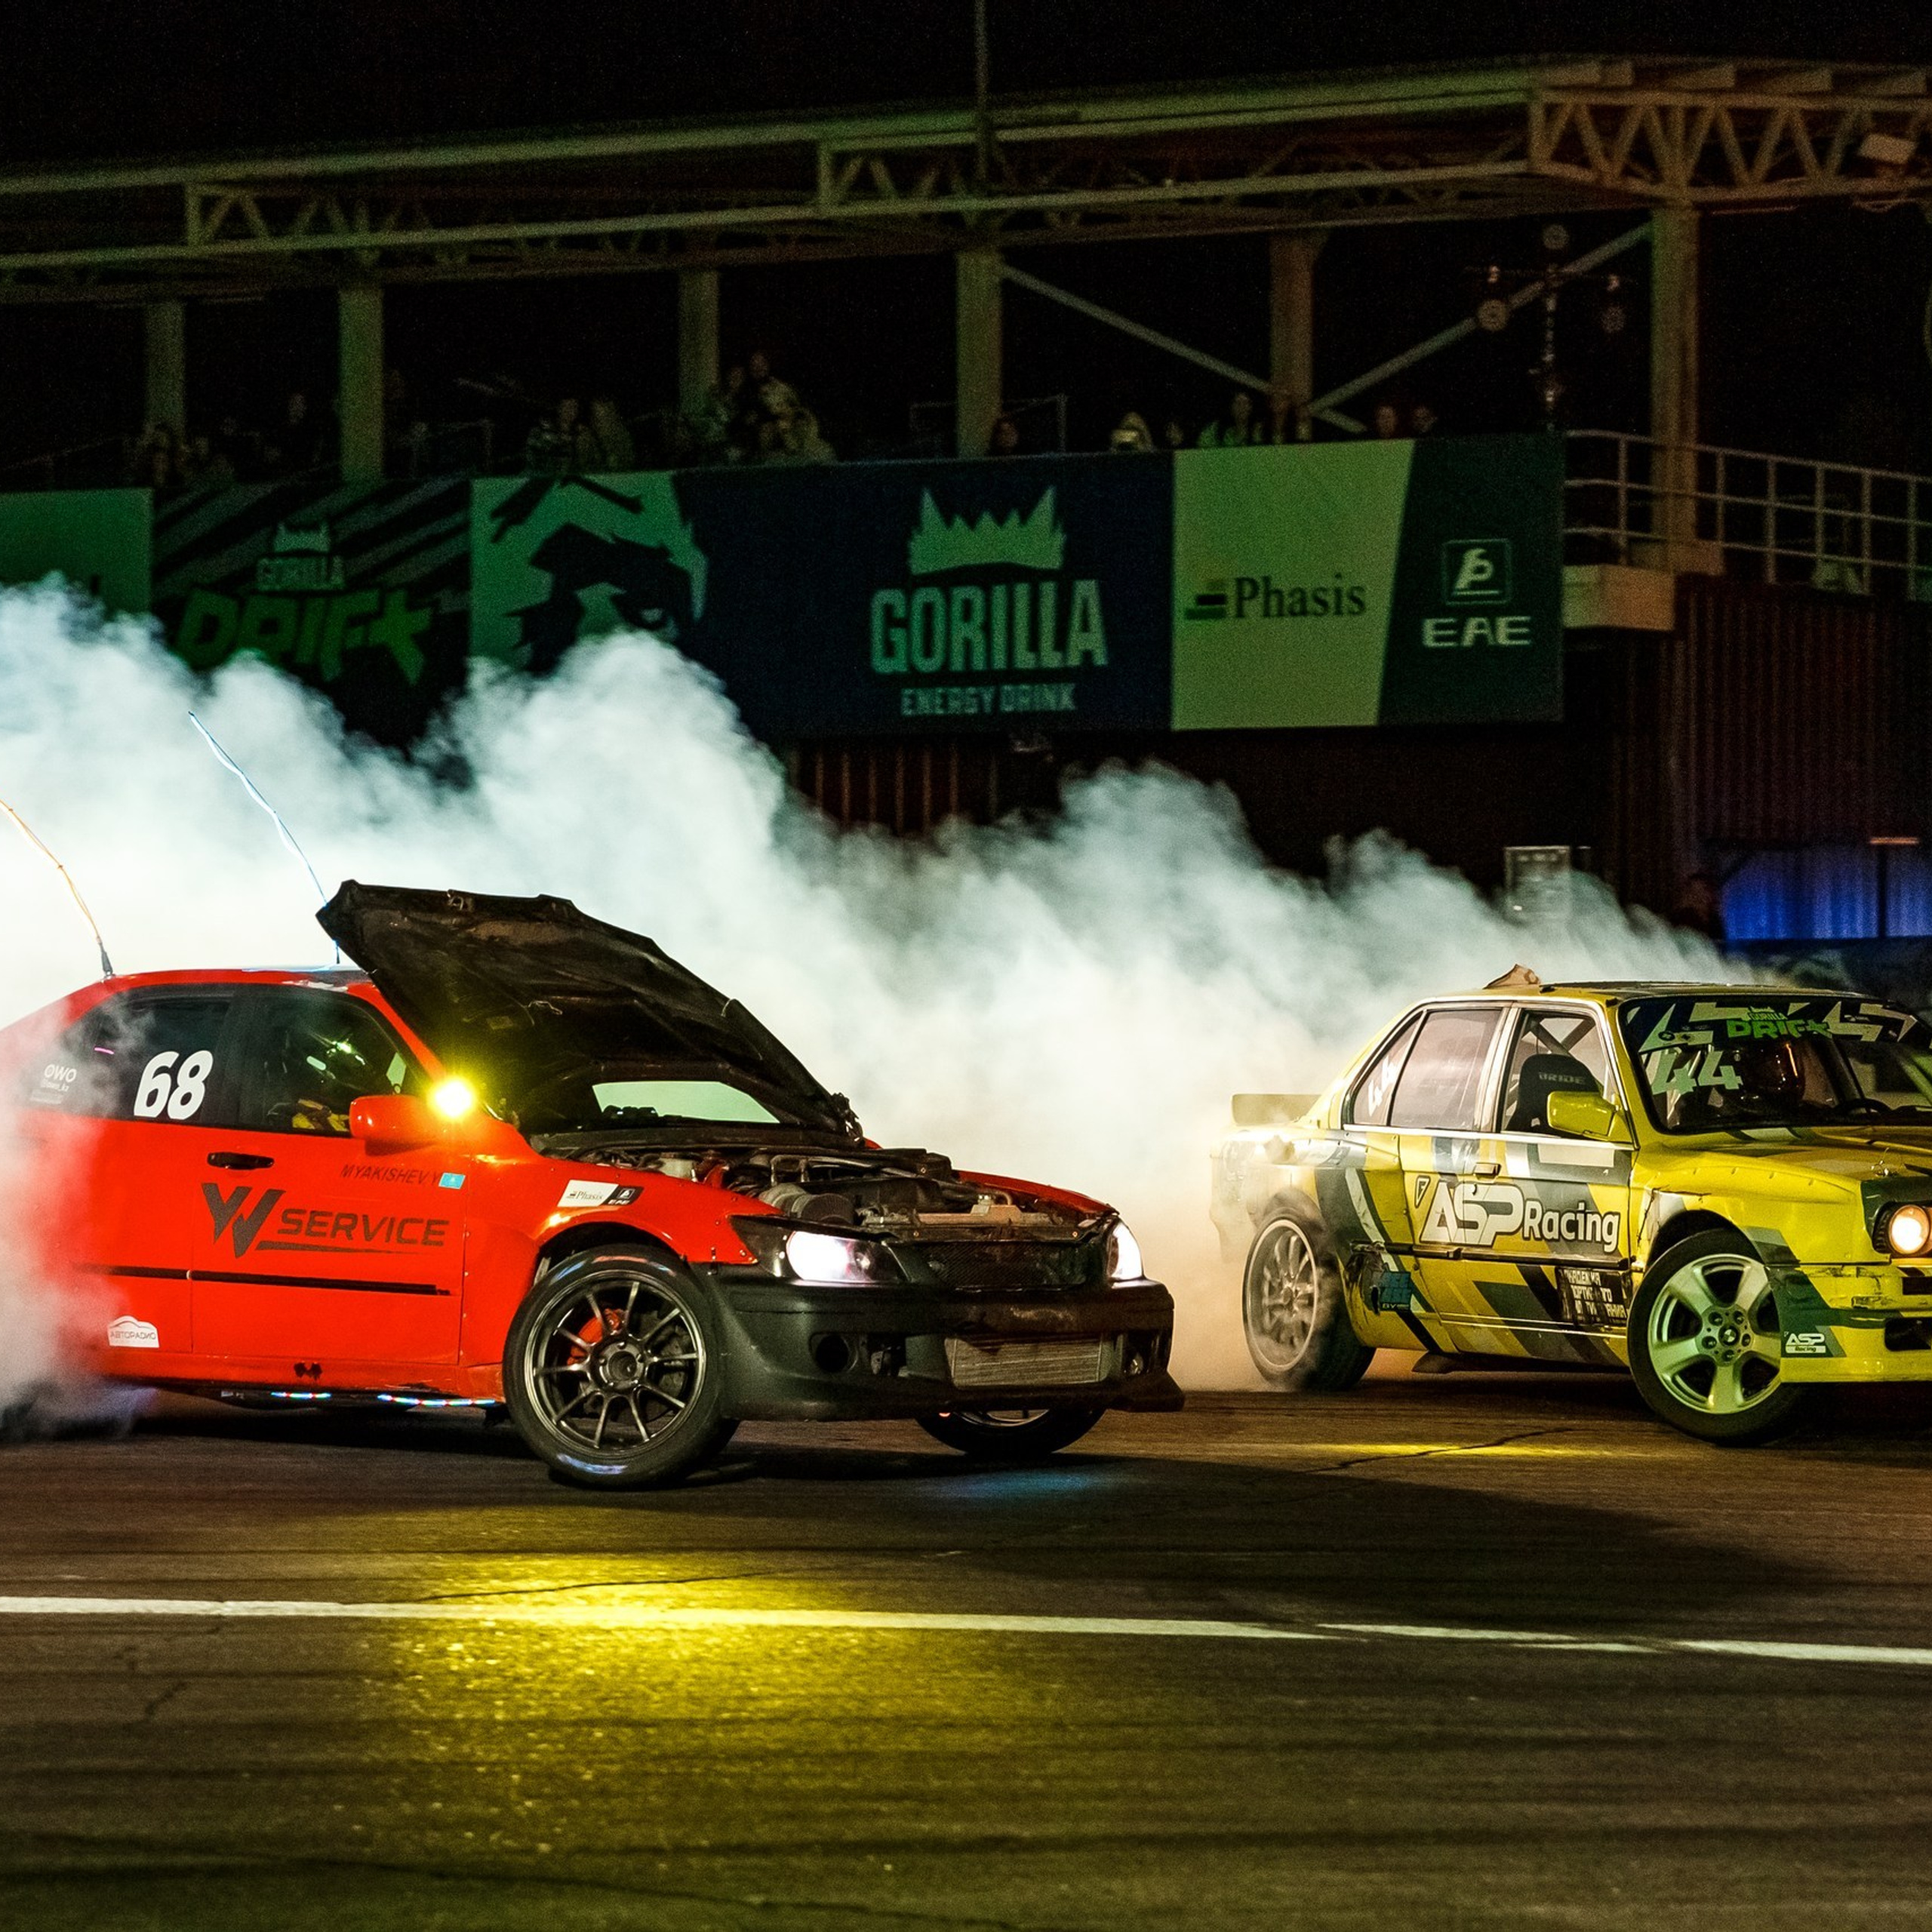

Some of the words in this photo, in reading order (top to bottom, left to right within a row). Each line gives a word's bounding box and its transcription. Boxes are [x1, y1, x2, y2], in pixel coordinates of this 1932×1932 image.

[1235, 572, 1367, 618] Phasis
[871, 580, 1108, 673] GORILLA
[1422, 616, 1531, 647] EAE
[902, 686, 994, 715] ENERGY
[1000, 683, 1075, 712] DRINK
[45, 1064, 77, 1083] OWO
[134, 1050, 214, 1120] 68
[1651, 1051, 1743, 1095] 44
[341, 1164, 430, 1185] MYAKISHEV
[278, 1208, 450, 1246] SERVICE
[1420, 1181, 1524, 1245] ASP
[1524, 1201, 1619, 1252] Racing
[1786, 1333, 1825, 1345] ASP
